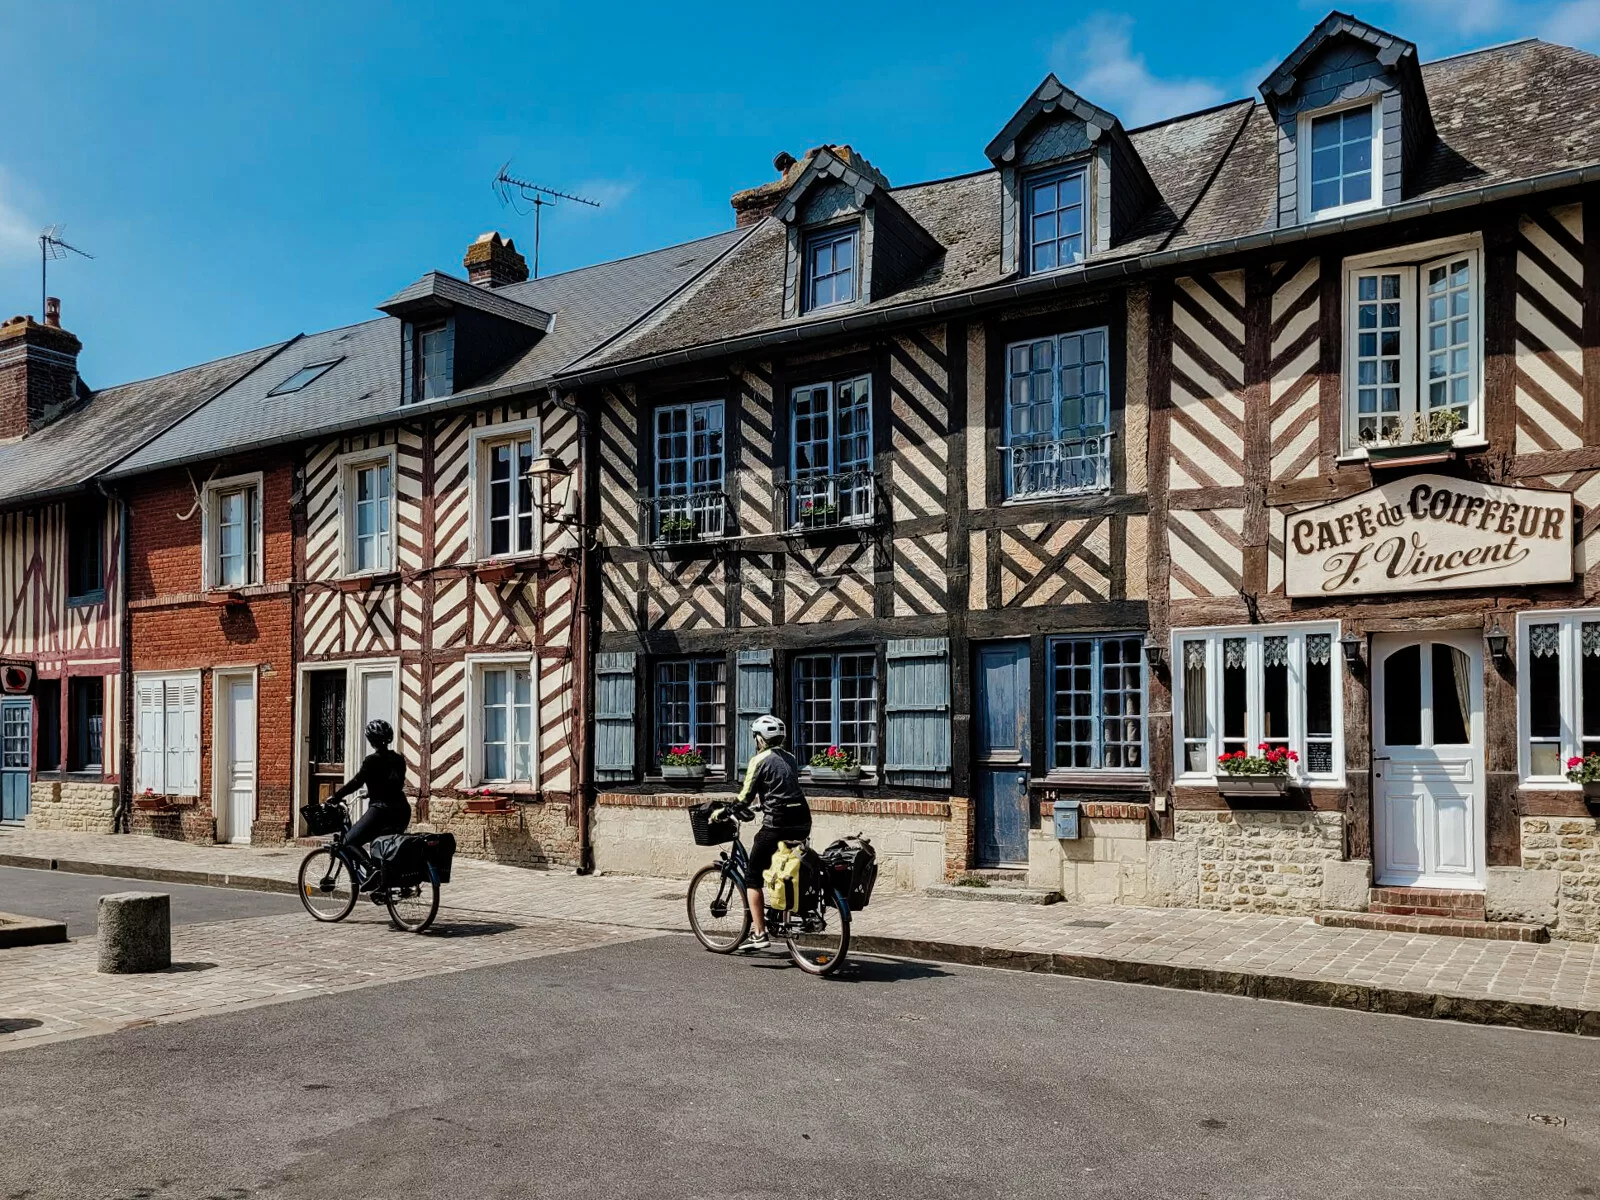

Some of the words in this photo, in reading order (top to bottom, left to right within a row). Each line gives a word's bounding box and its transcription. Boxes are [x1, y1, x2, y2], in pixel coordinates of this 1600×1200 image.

[1292, 504, 1377, 555] CAFÉ
[1376, 502, 1406, 527] du
[1407, 484, 1566, 540] COIFFEUR
[1373, 531, 1530, 583] Vincent
[1045, 790, 1056, 800] 14
